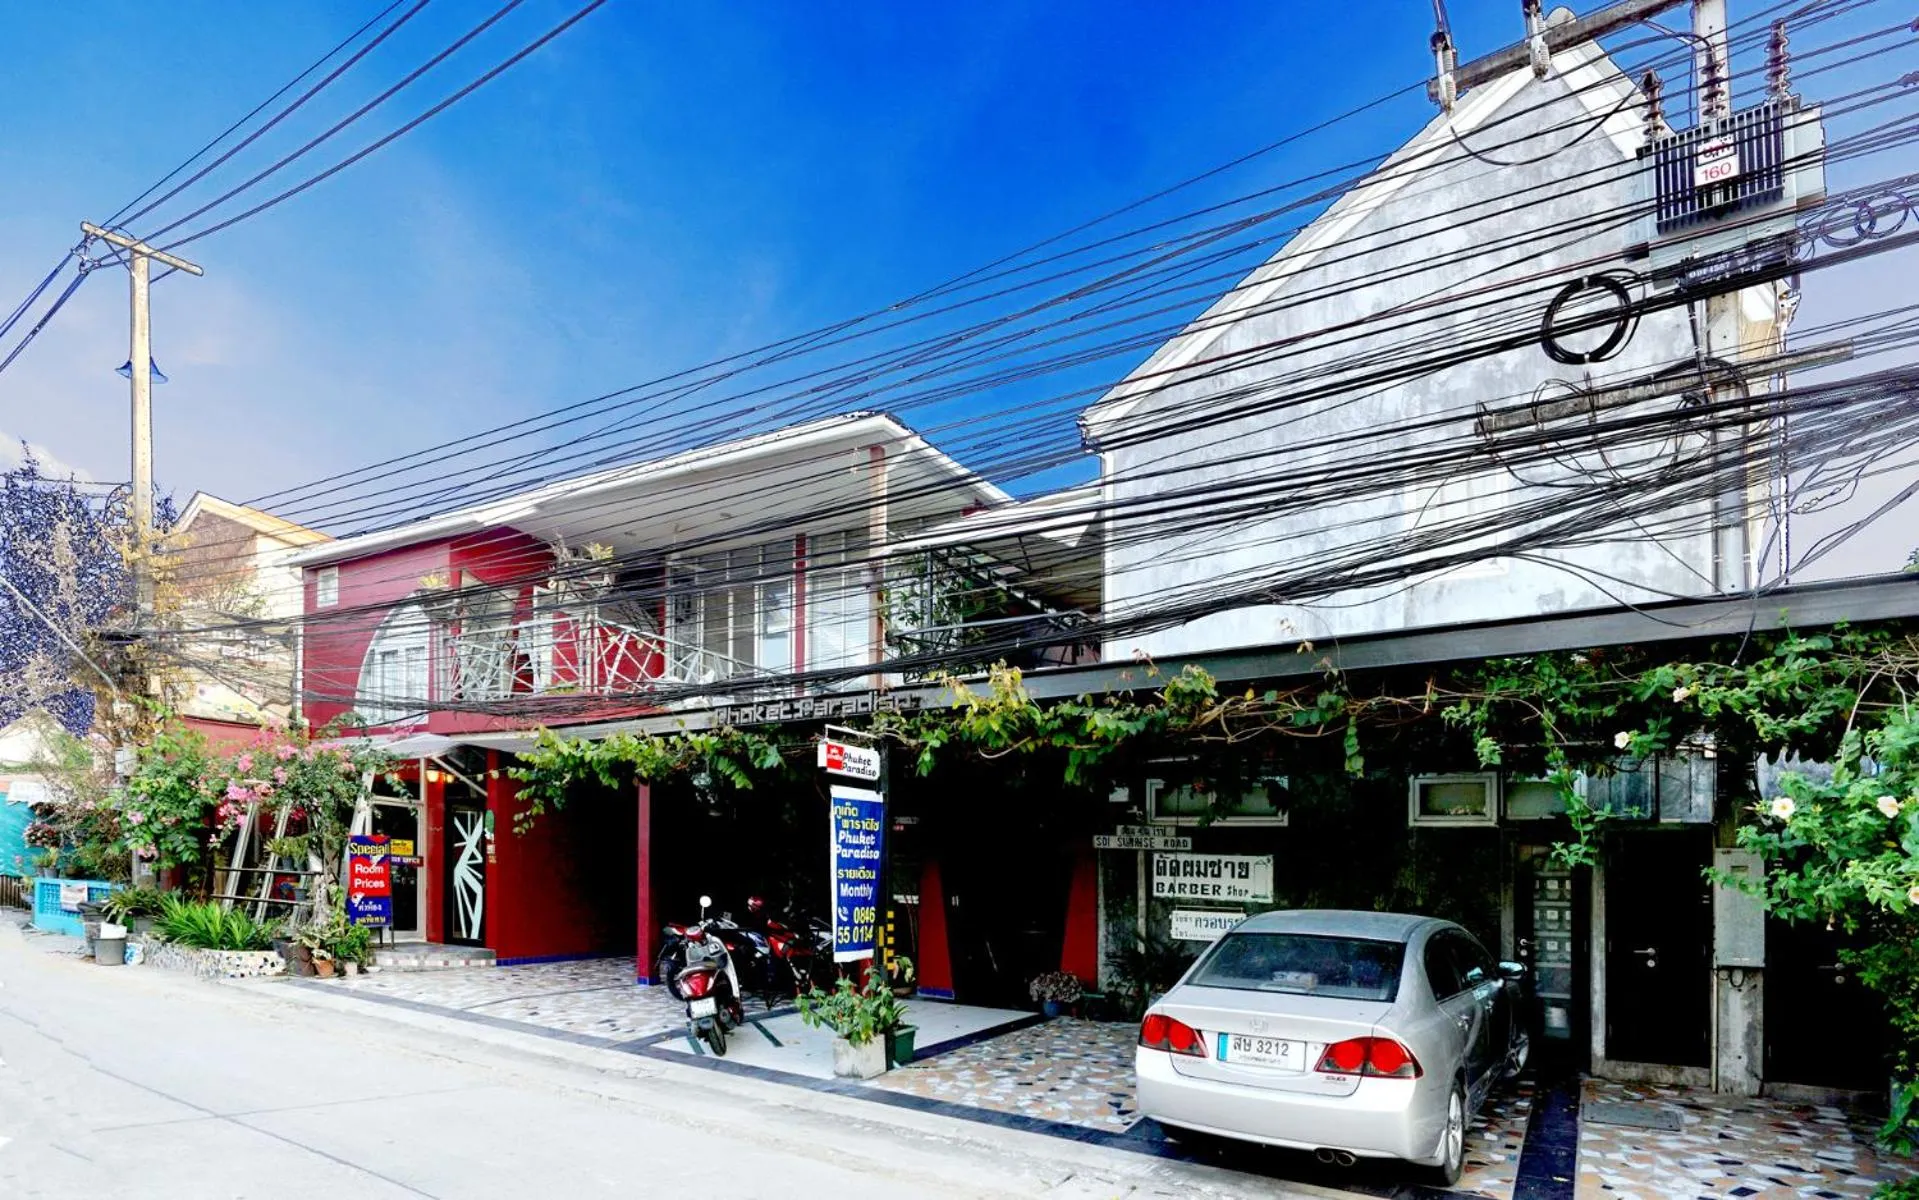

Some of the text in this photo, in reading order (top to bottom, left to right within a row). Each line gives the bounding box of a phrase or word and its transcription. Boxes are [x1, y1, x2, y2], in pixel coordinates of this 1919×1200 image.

[1701, 161, 1732, 181] 160
[843, 752, 872, 766] Phuket
[842, 761, 877, 777] Paradiso
[838, 829, 876, 846] Phuket
[1095, 836, 1110, 847] SOI
[1163, 838, 1189, 849] ROAD
[350, 842, 388, 856] Special
[836, 843, 880, 860] Paradiso
[355, 864, 384, 875] Room
[1155, 853, 1250, 880] ตัดผมชาย
[354, 878, 385, 889] Prices
[840, 882, 874, 901] Monthly
[1155, 881, 1222, 896] BARBER
[837, 925, 851, 945] 55
[1256, 1039, 1289, 1058] 3212
